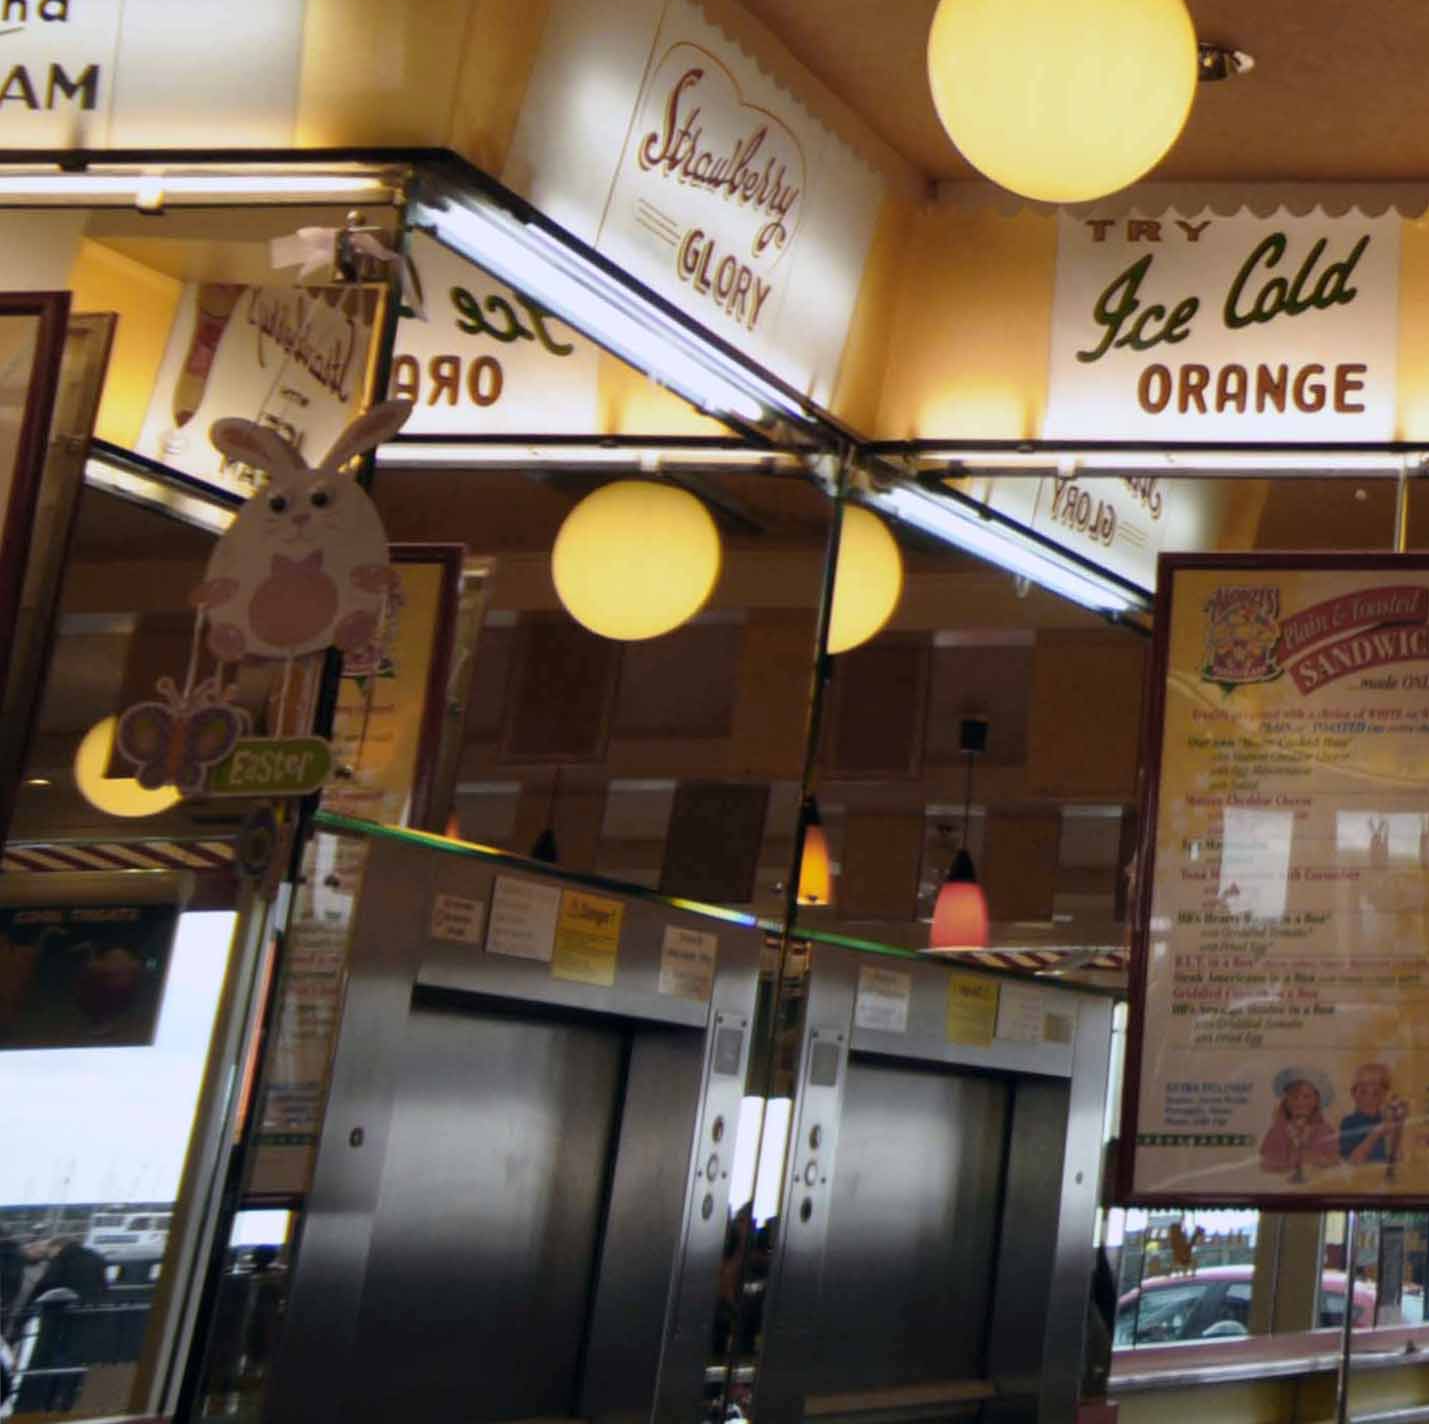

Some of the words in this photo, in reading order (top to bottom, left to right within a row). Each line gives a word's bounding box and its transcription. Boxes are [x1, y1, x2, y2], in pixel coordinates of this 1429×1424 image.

[640, 66, 801, 258] Strawberry
[1086, 219, 1213, 244] TRY
[676, 227, 775, 335] GLORY
[1075, 251, 1198, 365] Ice
[1222, 231, 1373, 331] Cold
[1136, 362, 1369, 416] ORANGE
[1283, 613, 1331, 649] Plain
[1351, 591, 1420, 623] Toasted
